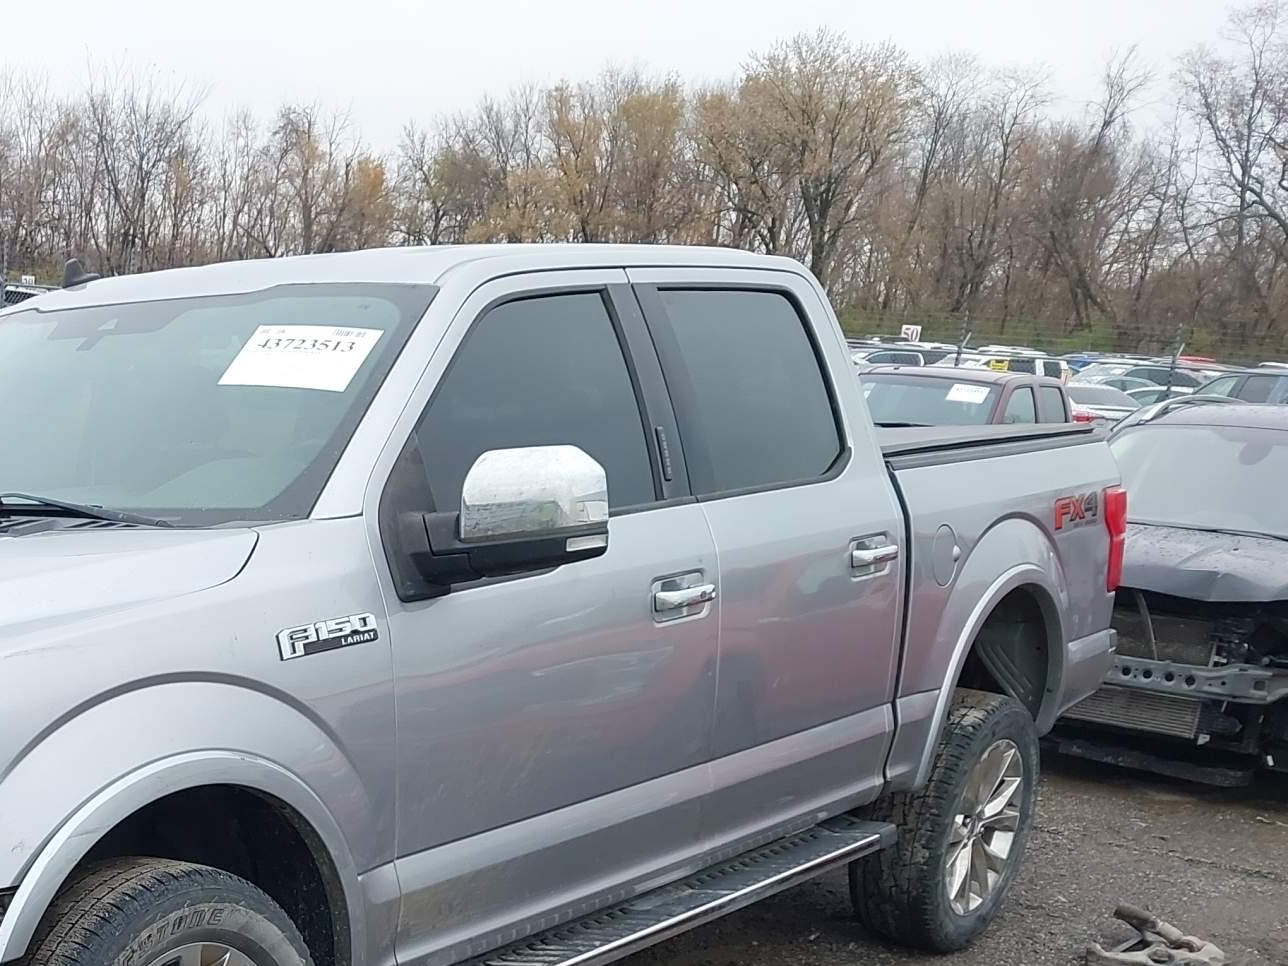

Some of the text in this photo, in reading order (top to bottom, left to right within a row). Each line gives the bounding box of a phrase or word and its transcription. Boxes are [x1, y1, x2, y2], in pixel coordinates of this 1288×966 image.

[258, 338, 356, 353] 43723513
[1055, 491, 1098, 530] FX4
[340, 631, 376, 646] LARIAT
